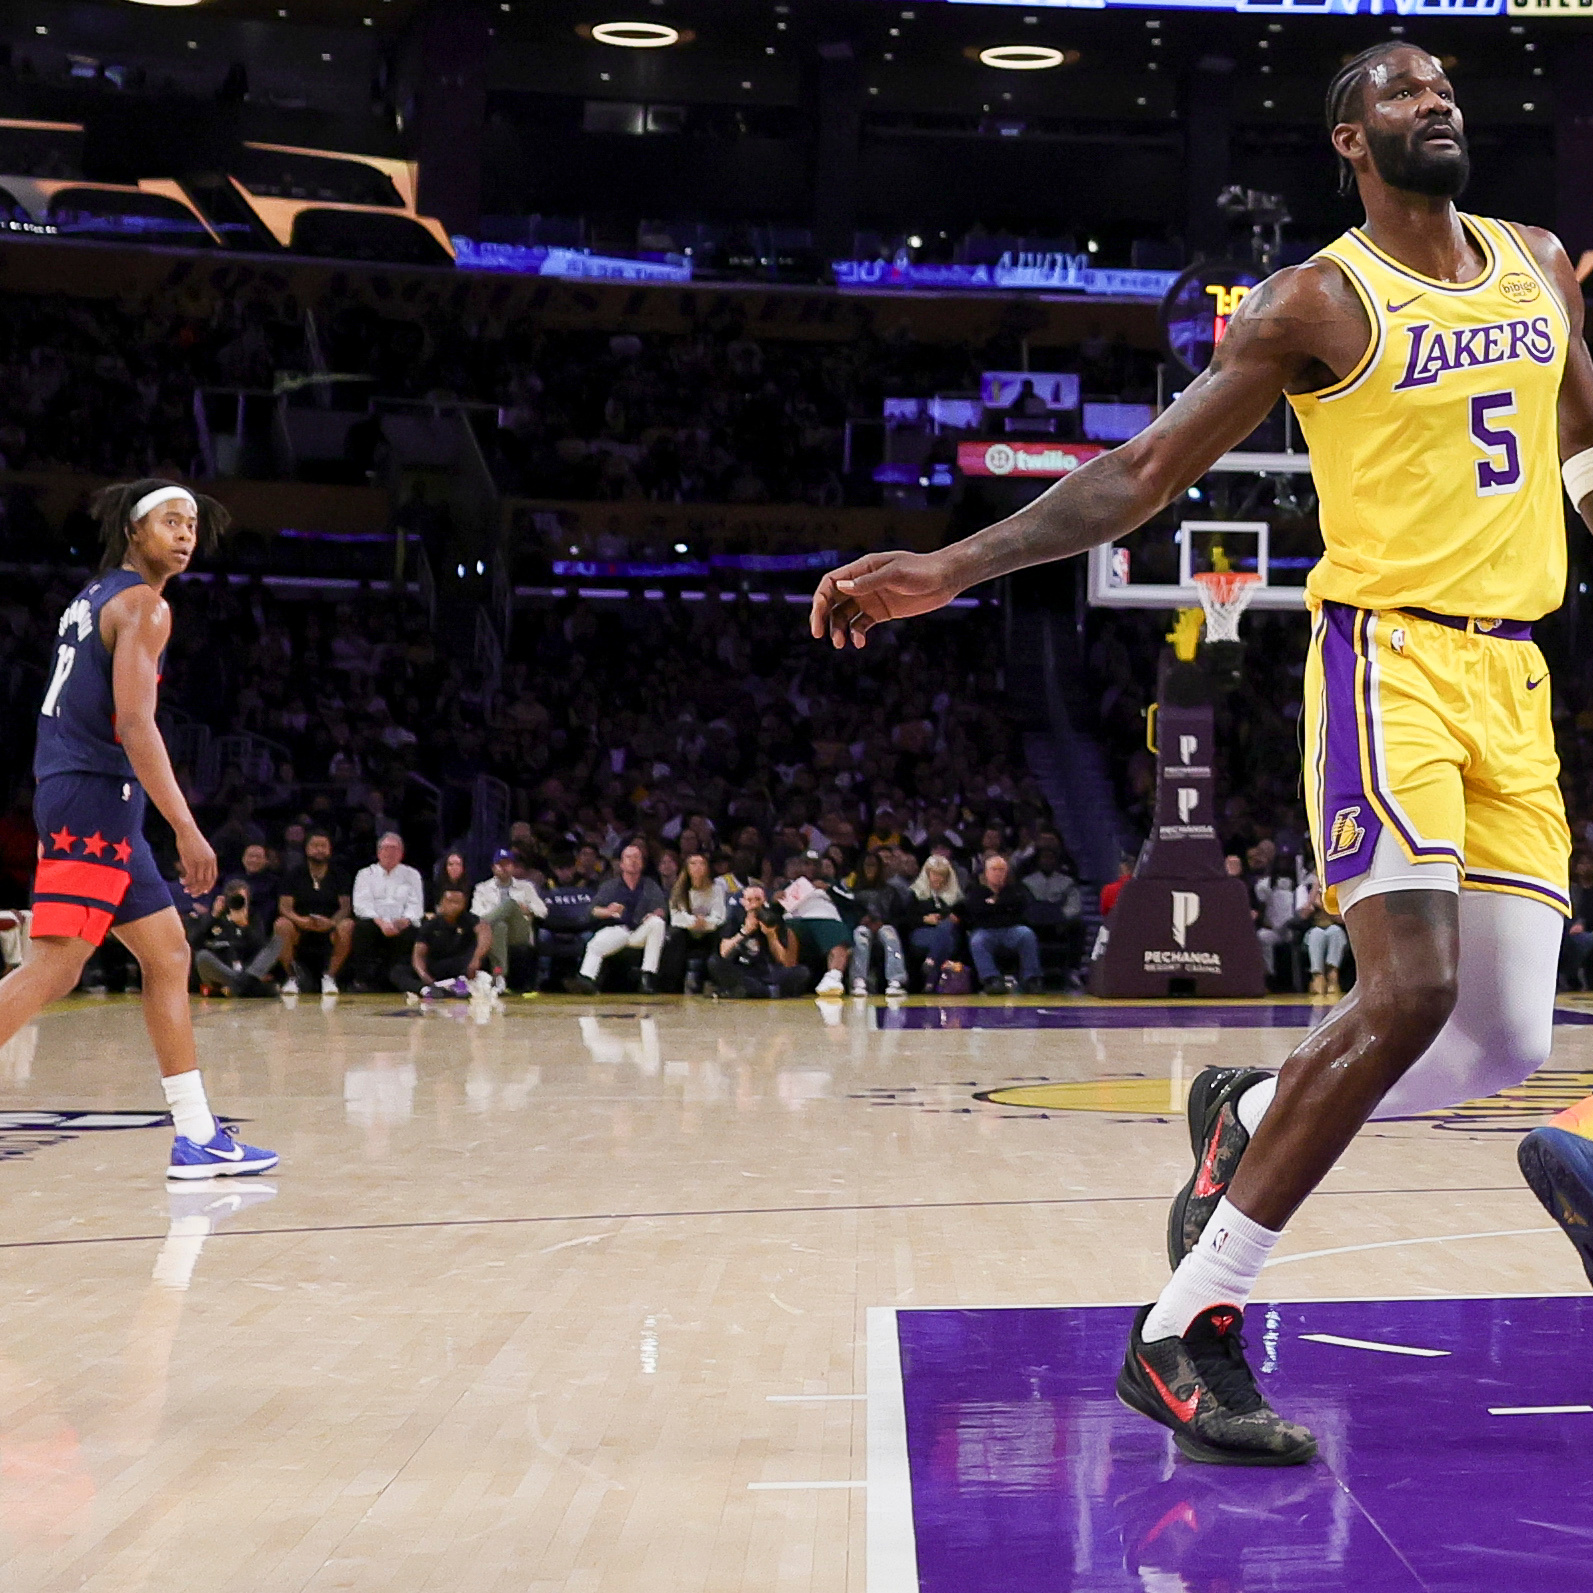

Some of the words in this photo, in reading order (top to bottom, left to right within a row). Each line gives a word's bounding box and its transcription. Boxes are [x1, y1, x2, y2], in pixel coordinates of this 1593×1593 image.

[1501, 280, 1538, 297] bibigo
[1393, 316, 1556, 393] LAKERS
[1469, 388, 1525, 498] 5
[1144, 950, 1221, 966] PECHANGA
